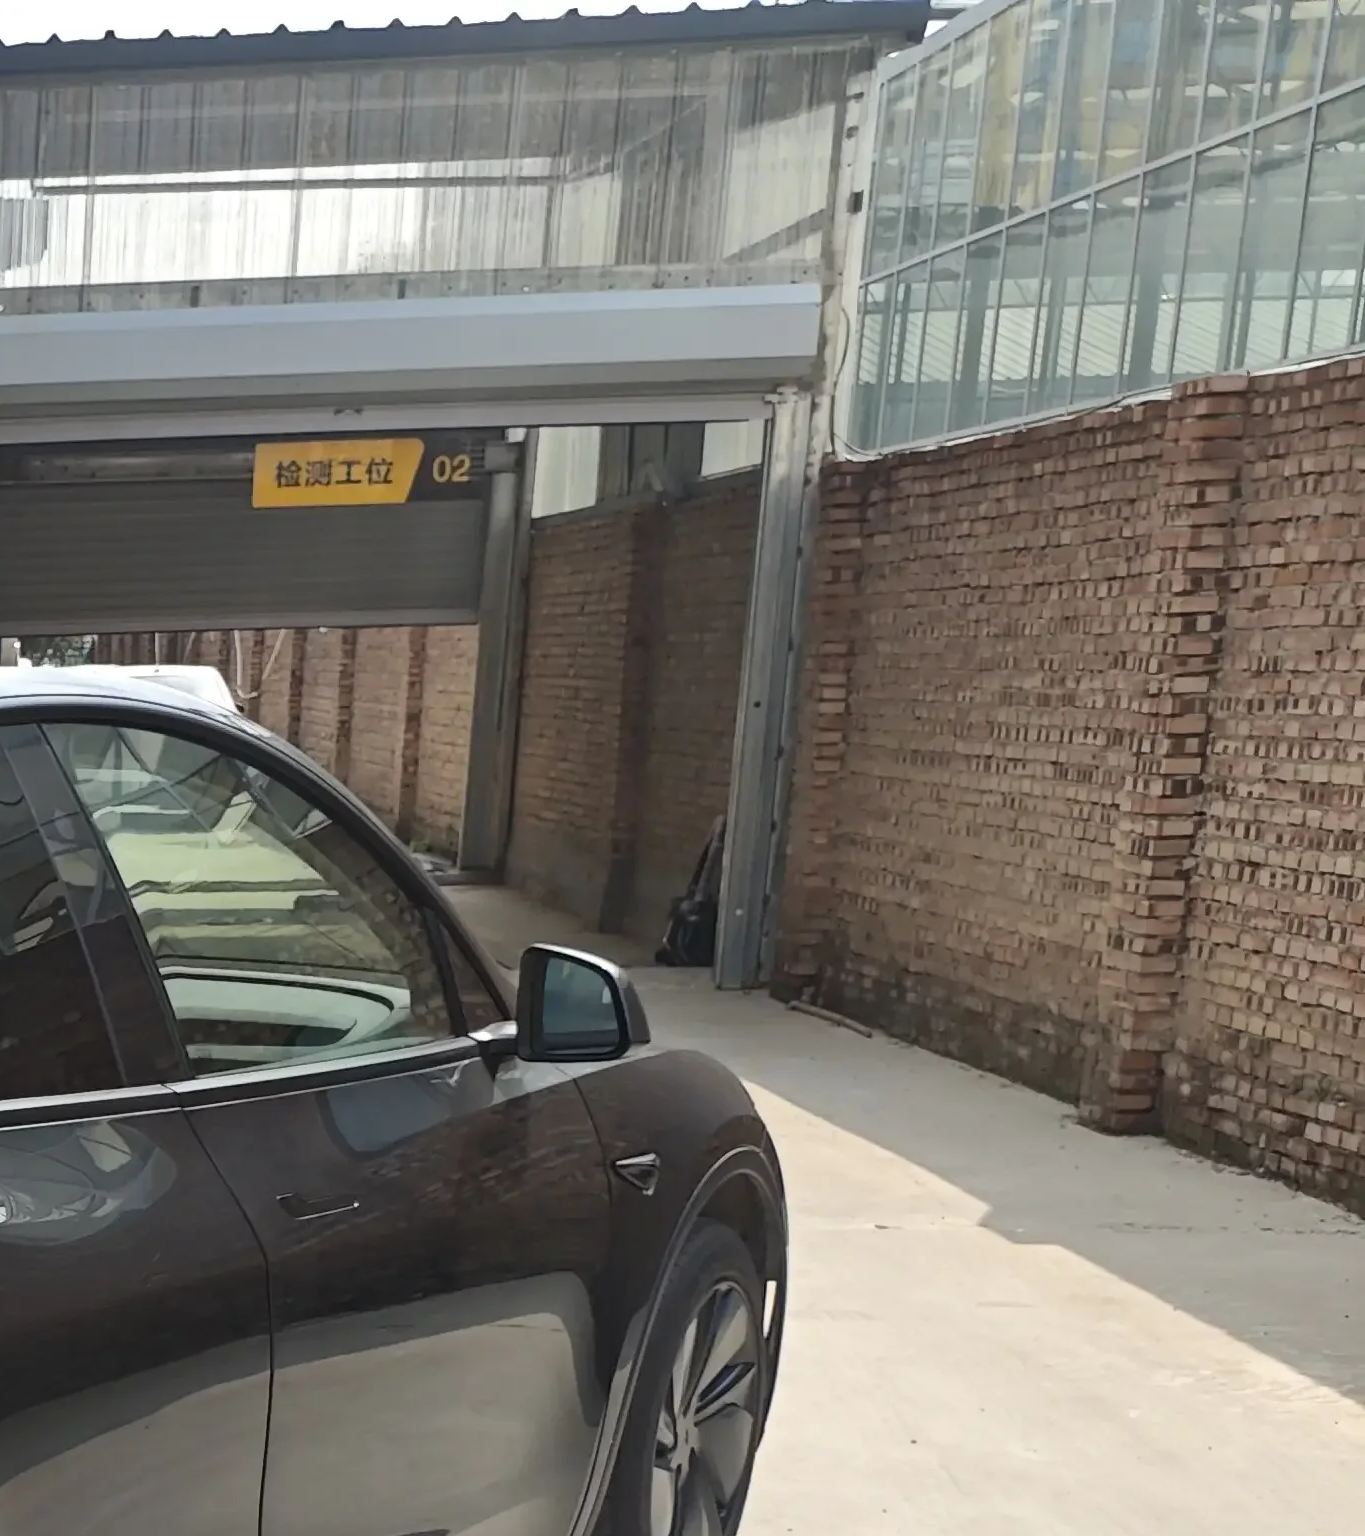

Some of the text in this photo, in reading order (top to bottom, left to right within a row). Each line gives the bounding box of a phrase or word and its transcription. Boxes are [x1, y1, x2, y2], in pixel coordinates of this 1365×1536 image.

[275, 454, 471, 489] 检测工位 02
